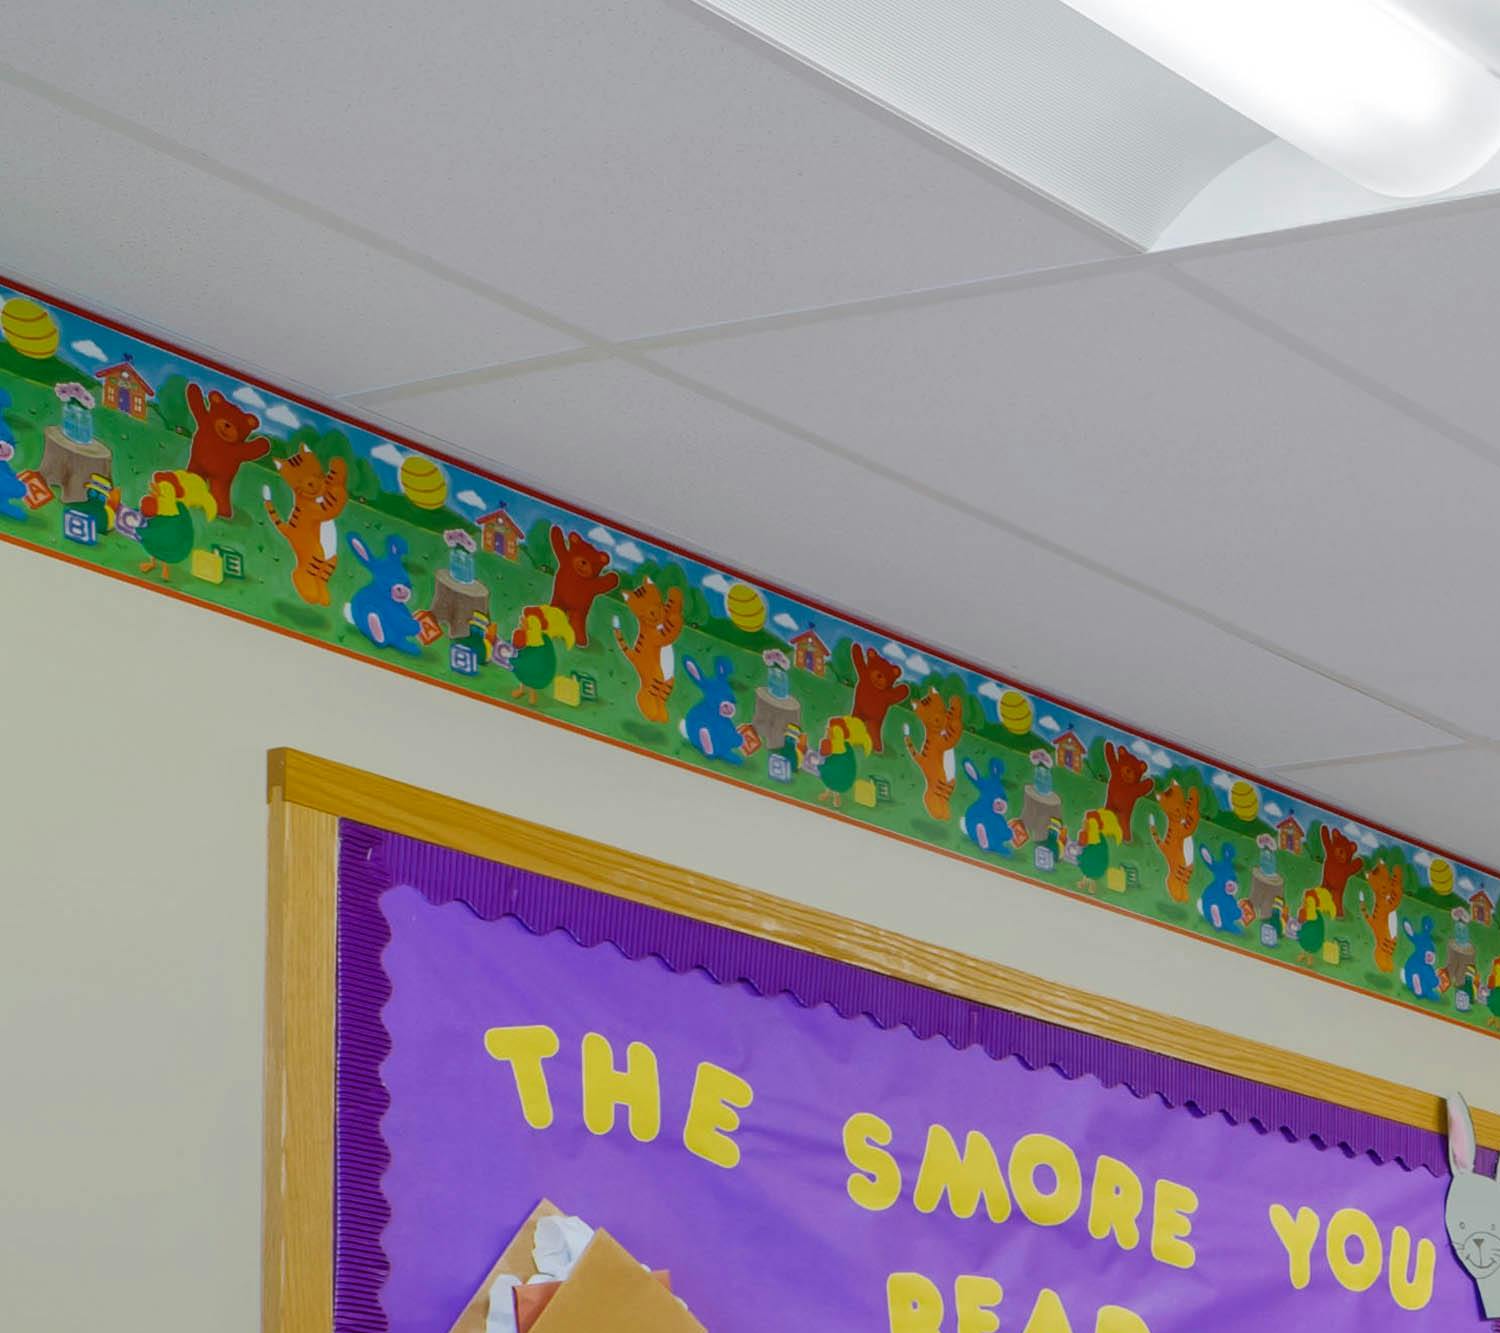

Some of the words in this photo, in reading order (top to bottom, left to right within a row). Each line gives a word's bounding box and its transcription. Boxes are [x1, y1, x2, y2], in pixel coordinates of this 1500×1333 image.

[485, 1025, 753, 1169] THE
[843, 1112, 1198, 1269] SMORE
[1270, 1205, 1435, 1310] YOU
